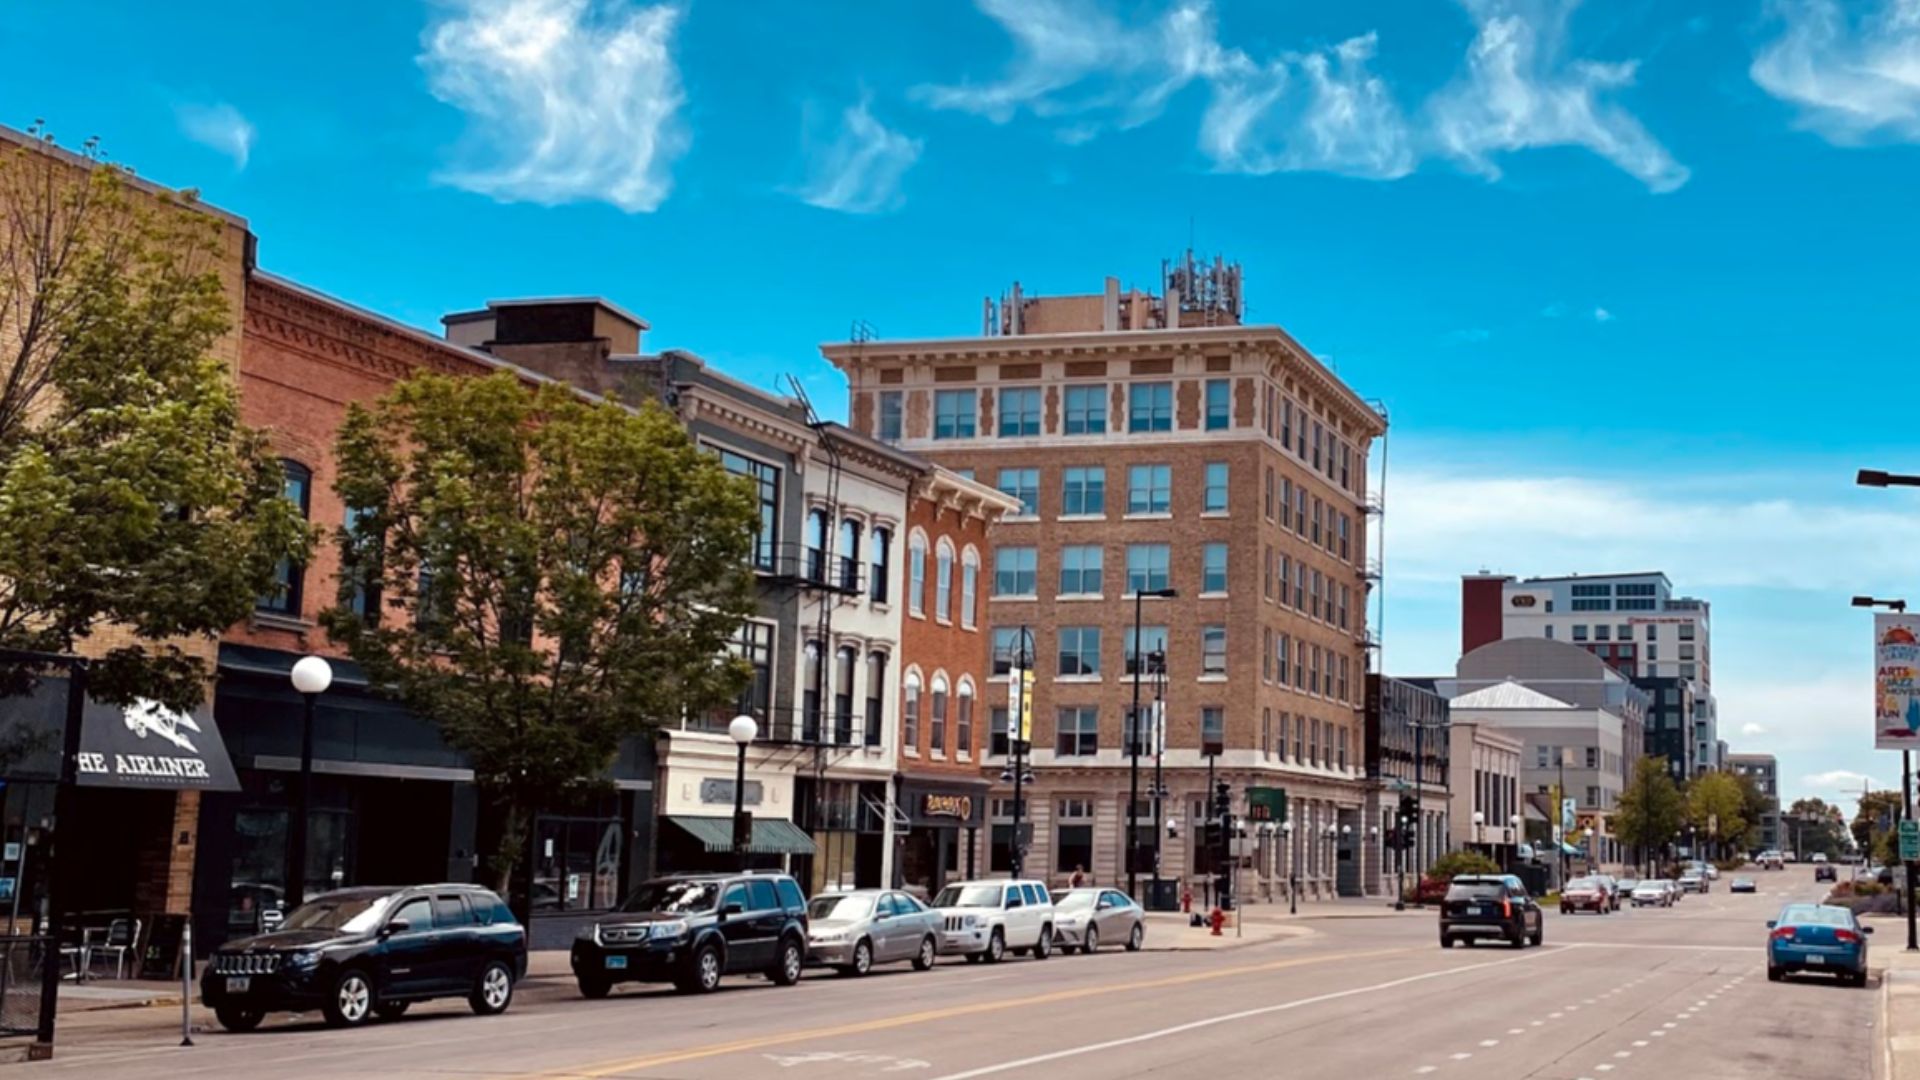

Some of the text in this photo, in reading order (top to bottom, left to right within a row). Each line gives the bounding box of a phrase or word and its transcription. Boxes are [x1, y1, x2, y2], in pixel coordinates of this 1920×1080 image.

[1878, 665, 1909, 676] ARTS
[76, 752, 210, 778] HE AIRLINER
